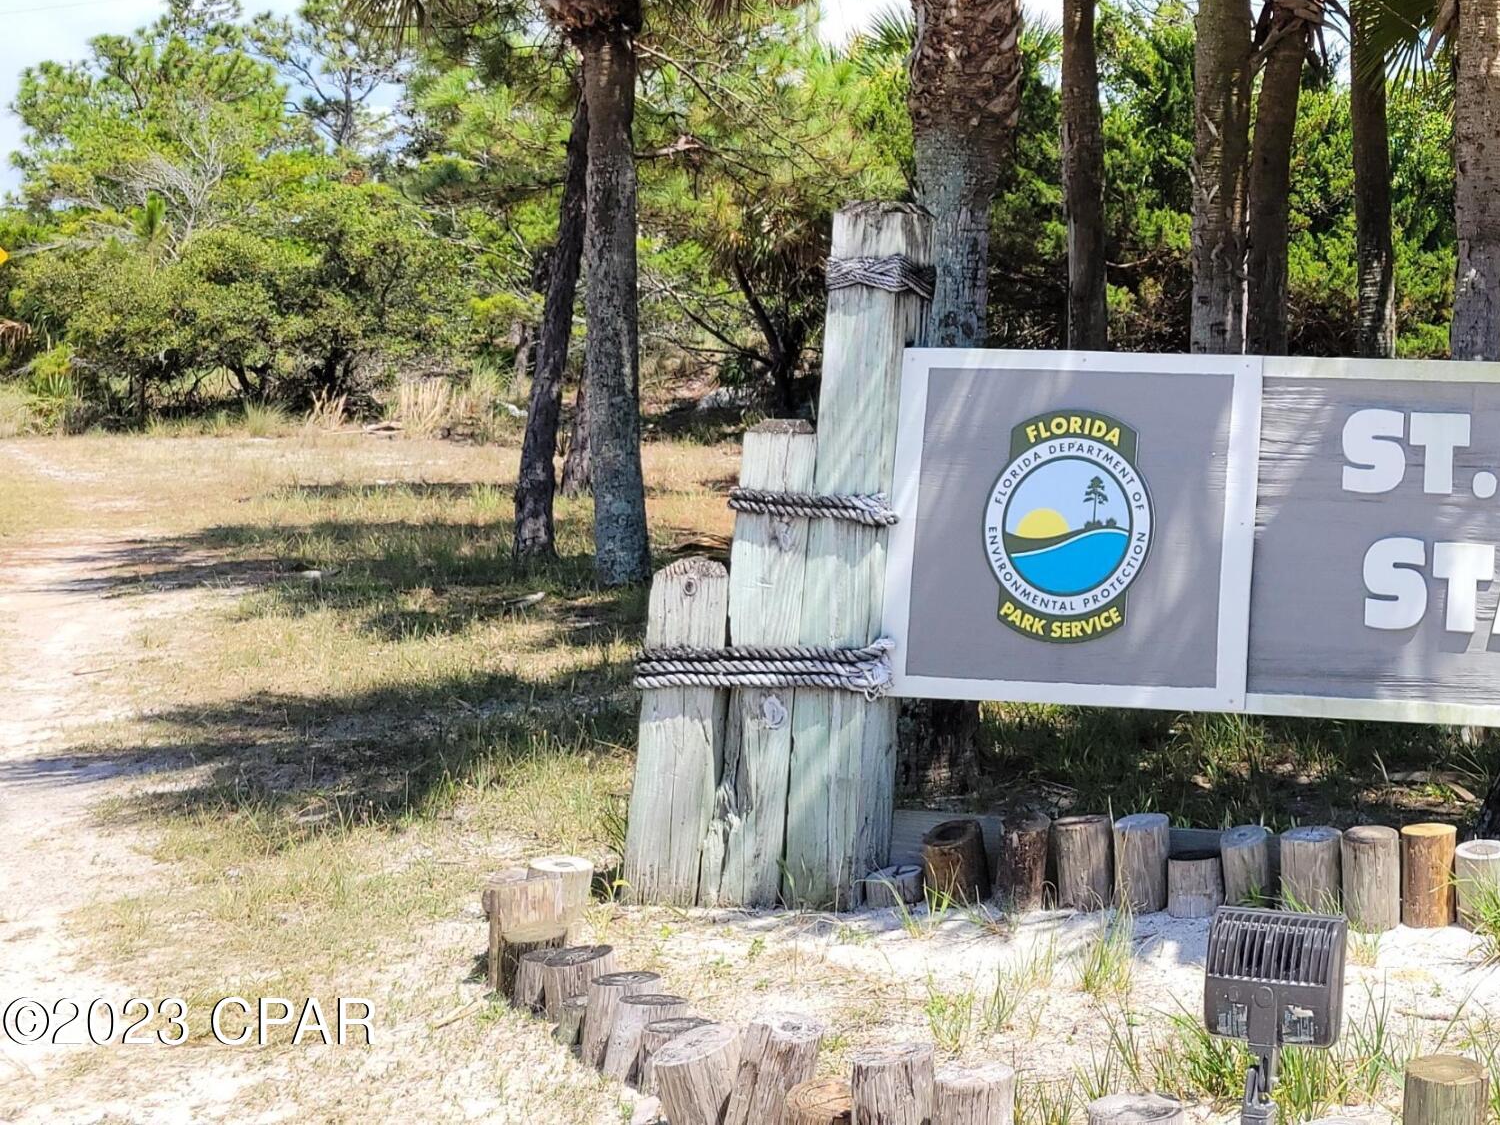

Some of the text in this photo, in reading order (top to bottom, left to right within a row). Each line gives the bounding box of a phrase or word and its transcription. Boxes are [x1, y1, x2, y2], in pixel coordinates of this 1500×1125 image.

[1025, 416, 1121, 446] FLORIDA
[1341, 408, 1498, 500] ST.
[994, 442, 1145, 511] FLORIDA DEPARTMENT OF
[988, 526, 1146, 612] ENVIRONMENTAL PROTECTION
[999, 601, 1122, 639] PARK SERVICE
